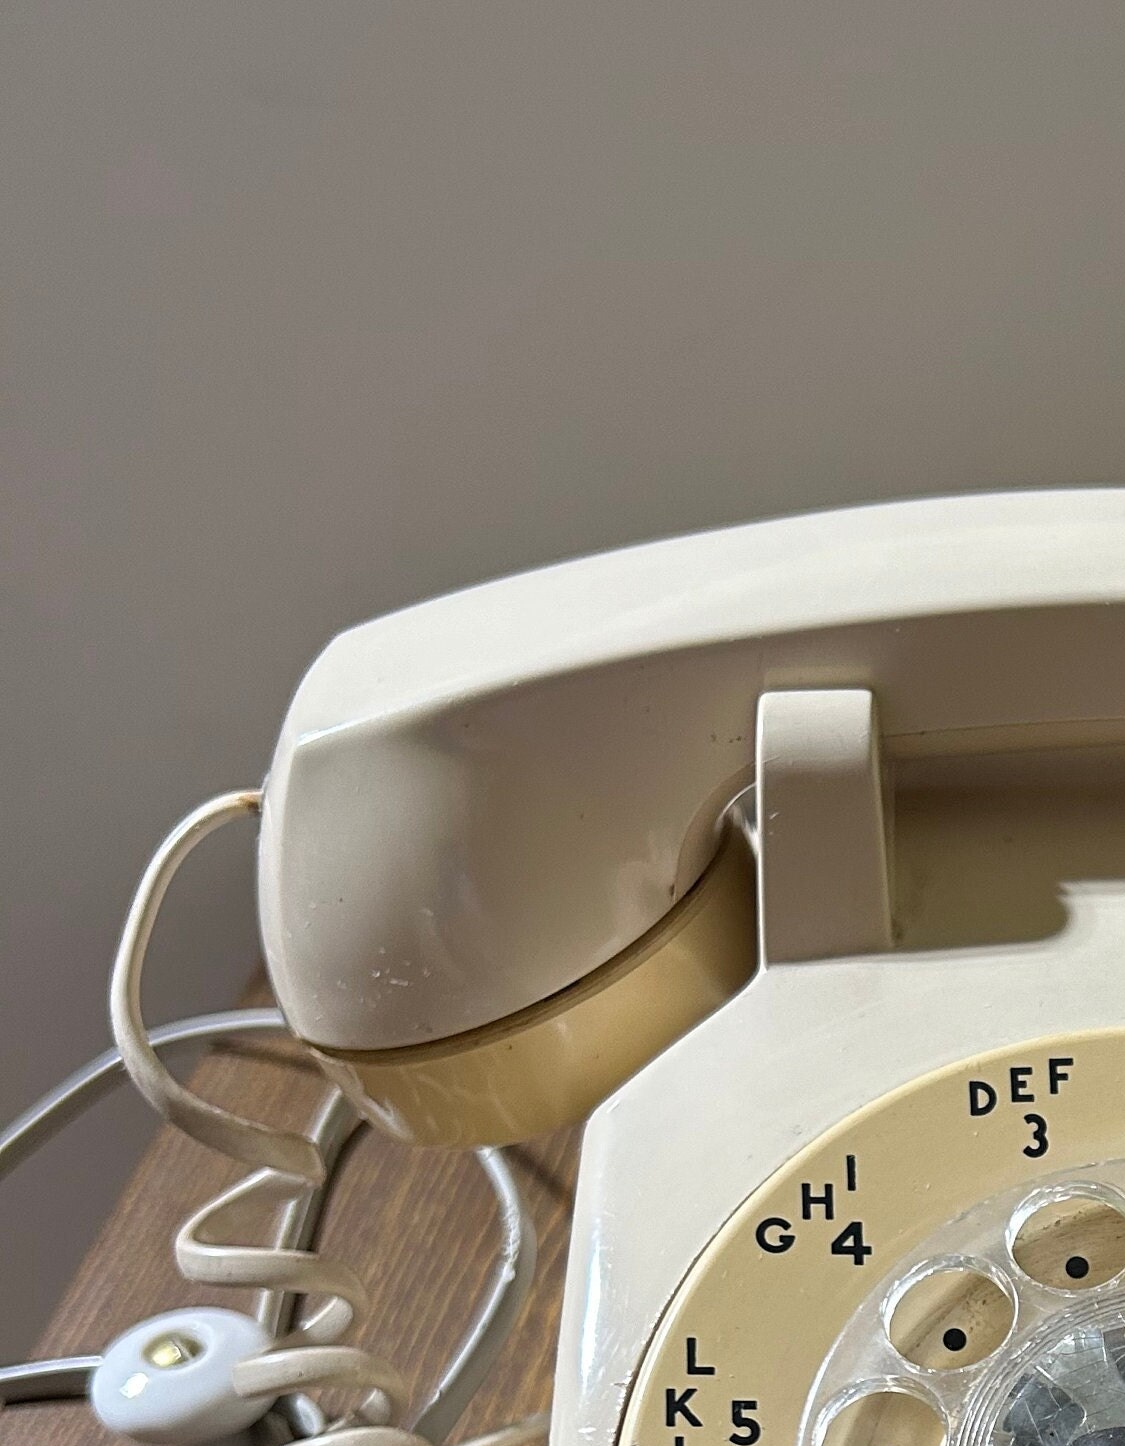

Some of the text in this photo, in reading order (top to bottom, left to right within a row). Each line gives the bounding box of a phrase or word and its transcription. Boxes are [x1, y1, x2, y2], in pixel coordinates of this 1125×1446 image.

[967, 1057, 1074, 1117] DEF
[1022, 1113, 1049, 1158] 3
[755, 1154, 856, 1254] GHI
[831, 1221, 872, 1266] 4
[728, 1400, 761, 1446] 5
